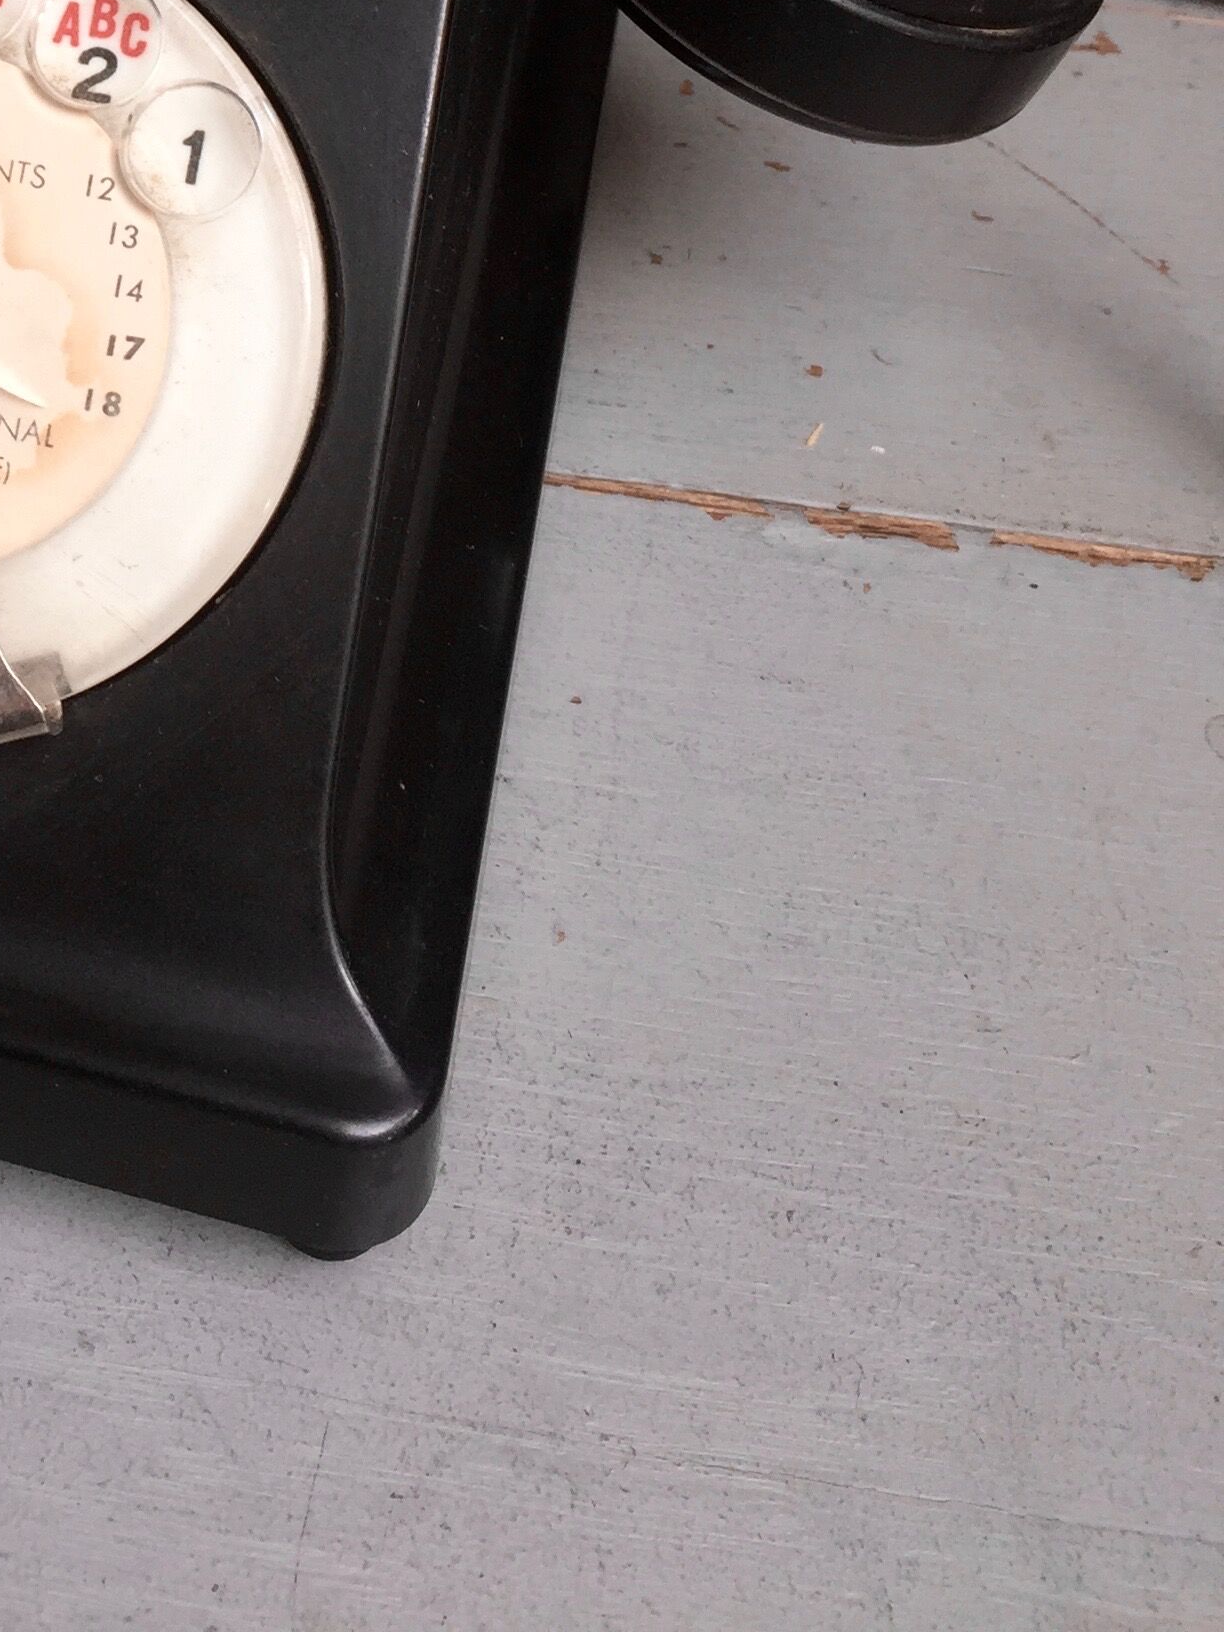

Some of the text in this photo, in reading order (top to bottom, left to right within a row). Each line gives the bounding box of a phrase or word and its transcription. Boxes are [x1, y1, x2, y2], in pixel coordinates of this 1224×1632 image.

[71, 46, 118, 104] 2
[182, 129, 205, 186] 1
[86, 174, 116, 201] 12
[109, 221, 139, 249] 13
[114, 274, 144, 302] 14
[106, 334, 146, 360] 17
[84, 388, 122, 417] 18
